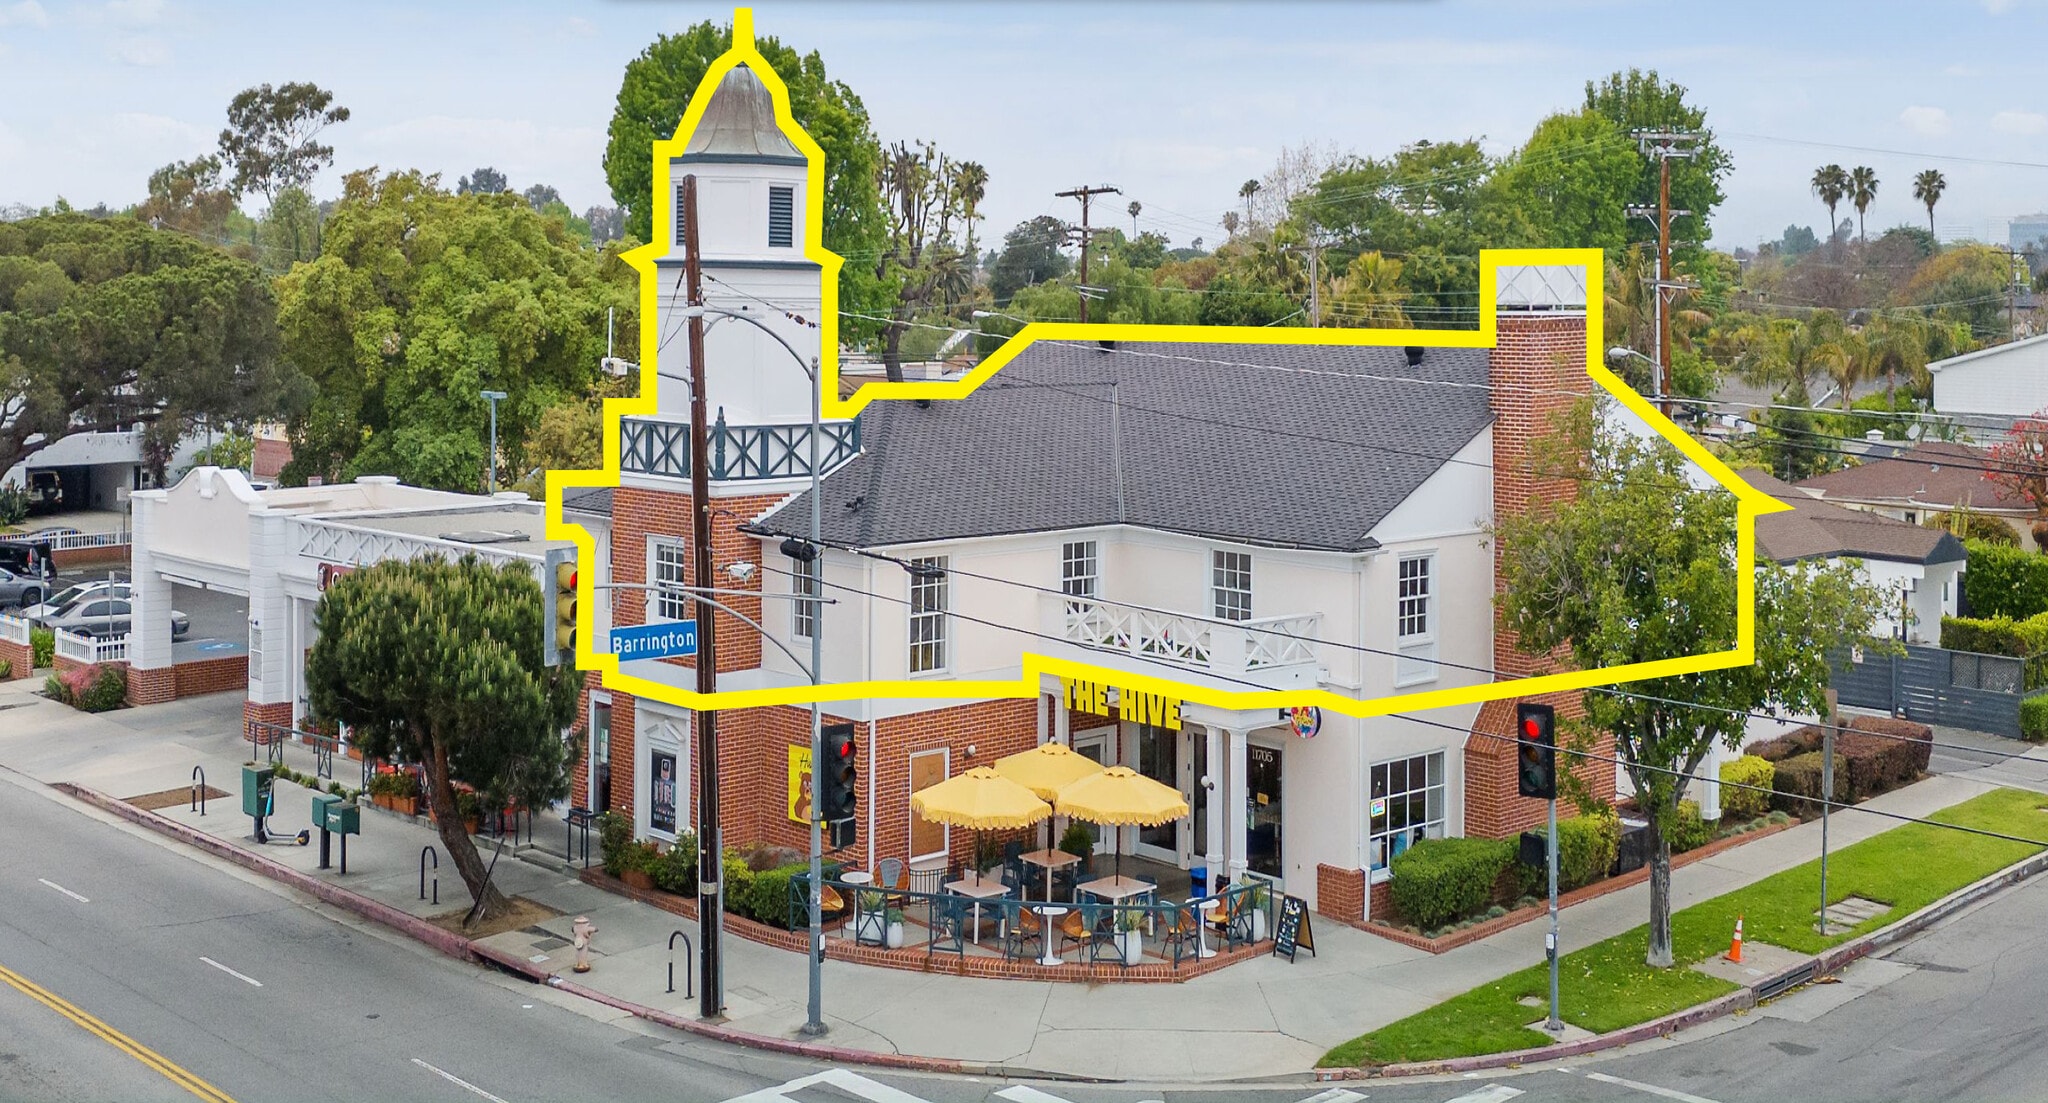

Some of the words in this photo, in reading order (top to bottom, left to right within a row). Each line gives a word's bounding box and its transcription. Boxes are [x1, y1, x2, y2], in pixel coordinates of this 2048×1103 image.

[612, 631, 695, 655] Barrington
[1060, 677, 1109, 717] THE
[1119, 687, 1182, 731] HIVE
[1252, 748, 1273, 763] 11705
